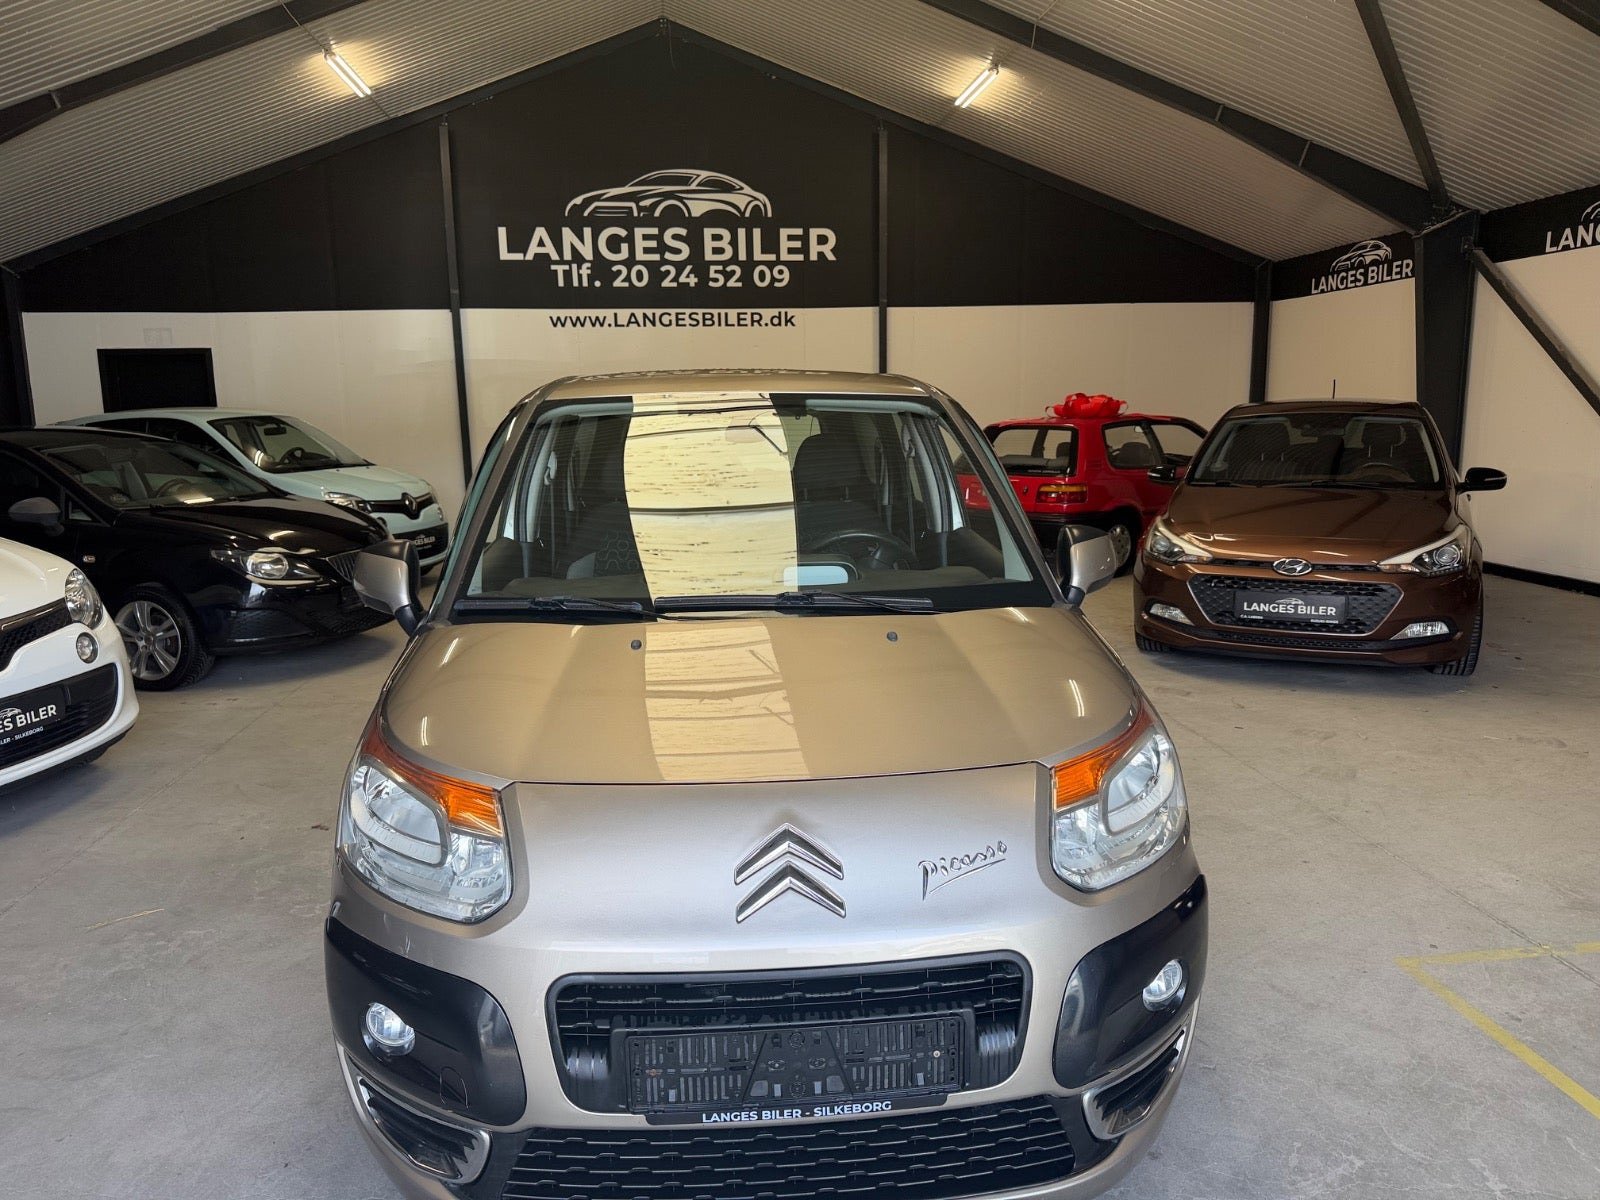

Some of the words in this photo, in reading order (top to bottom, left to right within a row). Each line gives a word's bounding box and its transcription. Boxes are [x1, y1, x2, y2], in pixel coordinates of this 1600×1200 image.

[497, 226, 690, 262] LANGES
[703, 227, 837, 262] BILER
[550, 262, 601, 288] Tlf.
[611, 264, 649, 288] 20
[660, 264, 698, 288] 24
[708, 264, 743, 288] 52
[753, 264, 790, 288] 09
[1311, 268, 1365, 295] LANGES
[1367, 259, 1414, 284] BILER
[549, 311, 796, 328] www.LANGESBILER.dk
[1243, 602, 1295, 613] LANGES
[1297, 605, 1337, 616] BILER
[16, 704, 57, 728] BILER
[14, 726, 44, 741] SILKEBORG
[702, 1110, 758, 1123] LANGES
[761, 1109, 802, 1120] BILER
[813, 1100, 893, 1118] SILKEBORG
